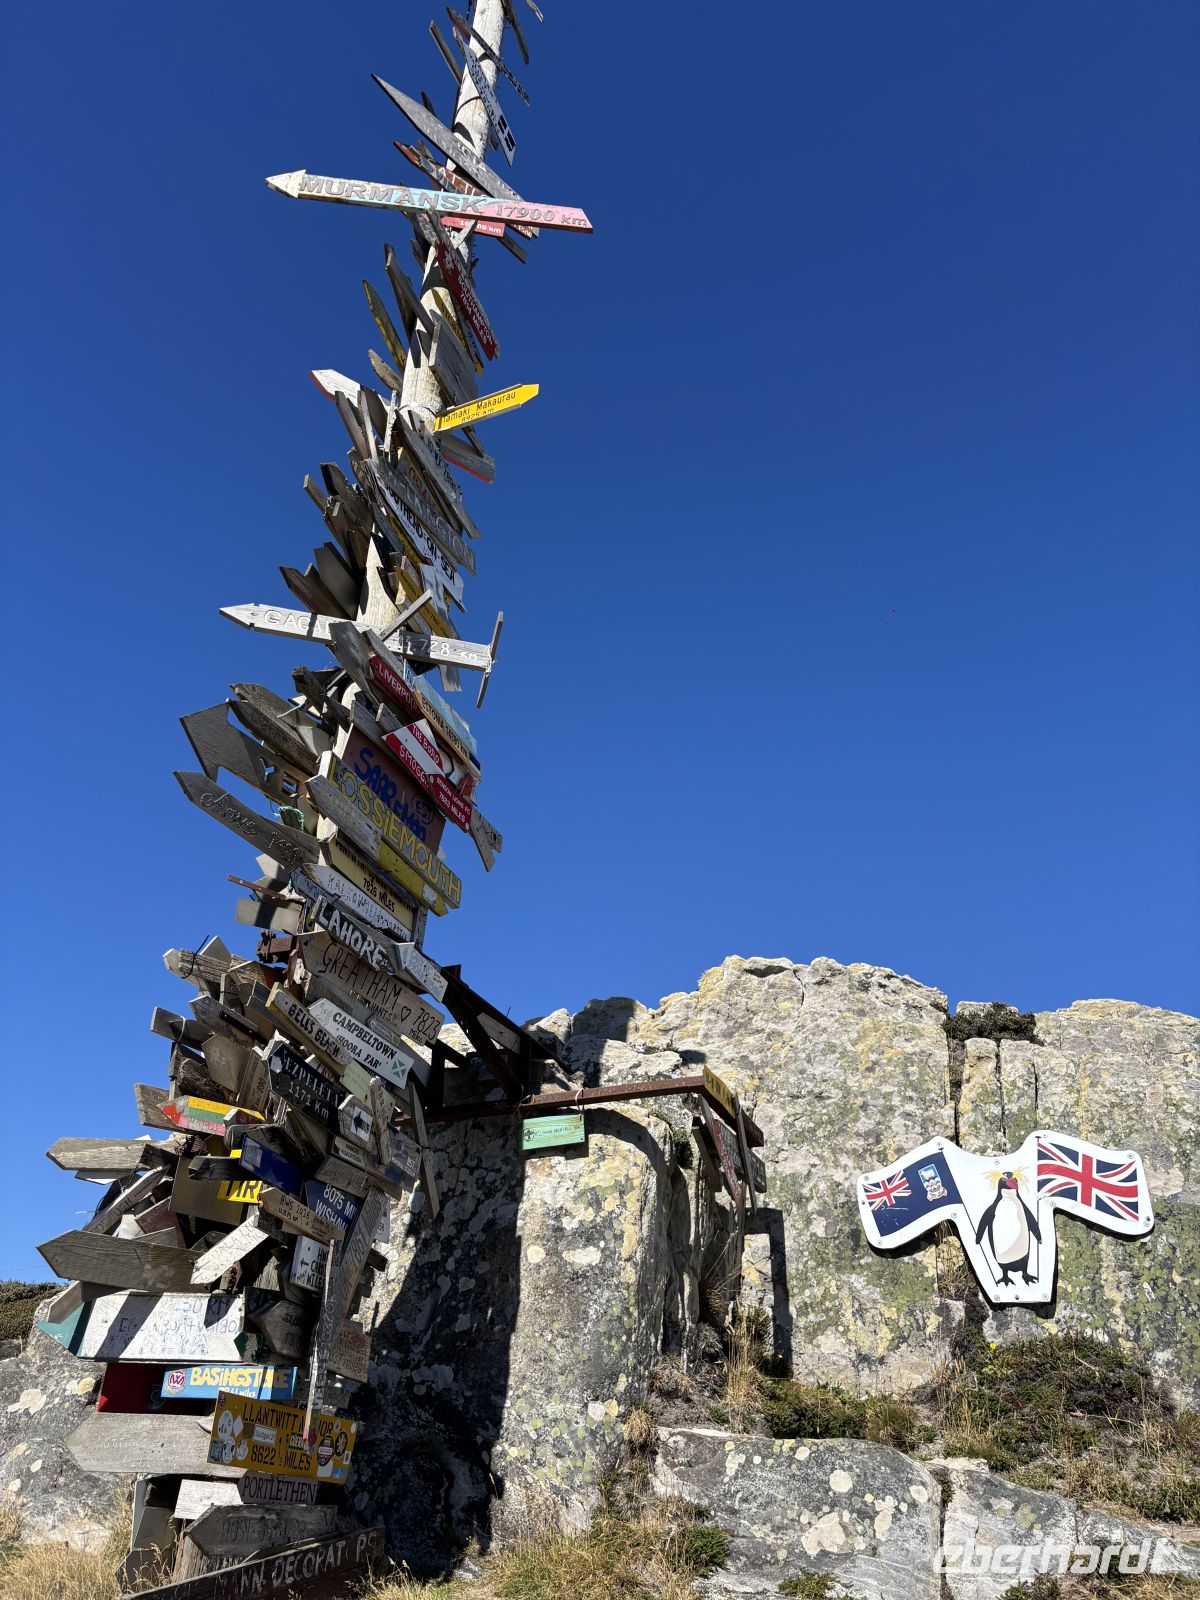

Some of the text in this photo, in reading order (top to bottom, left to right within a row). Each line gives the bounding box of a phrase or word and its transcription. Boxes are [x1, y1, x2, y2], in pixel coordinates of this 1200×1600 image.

[299, 175, 488, 214] MURMANSK
[496, 204, 556, 221] 17900
[562, 216, 590, 228] km
[476, 391, 517, 411] Makaurau
[330, 756, 463, 904] LOSSIEMOUTH
[319, 897, 387, 971] LAHORE
[320, 941, 402, 1012] GREATHAM
[414, 1007, 441, 1041] 7823
[332, 1010, 397, 1061] CAMPBELTOWN
[322, 1184, 345, 1211] 8075
[315, 1199, 349, 1231] WISHAW
[242, 1402, 299, 1432] LLANTWITT
[283, 1450, 312, 1473] MILES
[240, 1479, 318, 1504] PORTLETHEN
